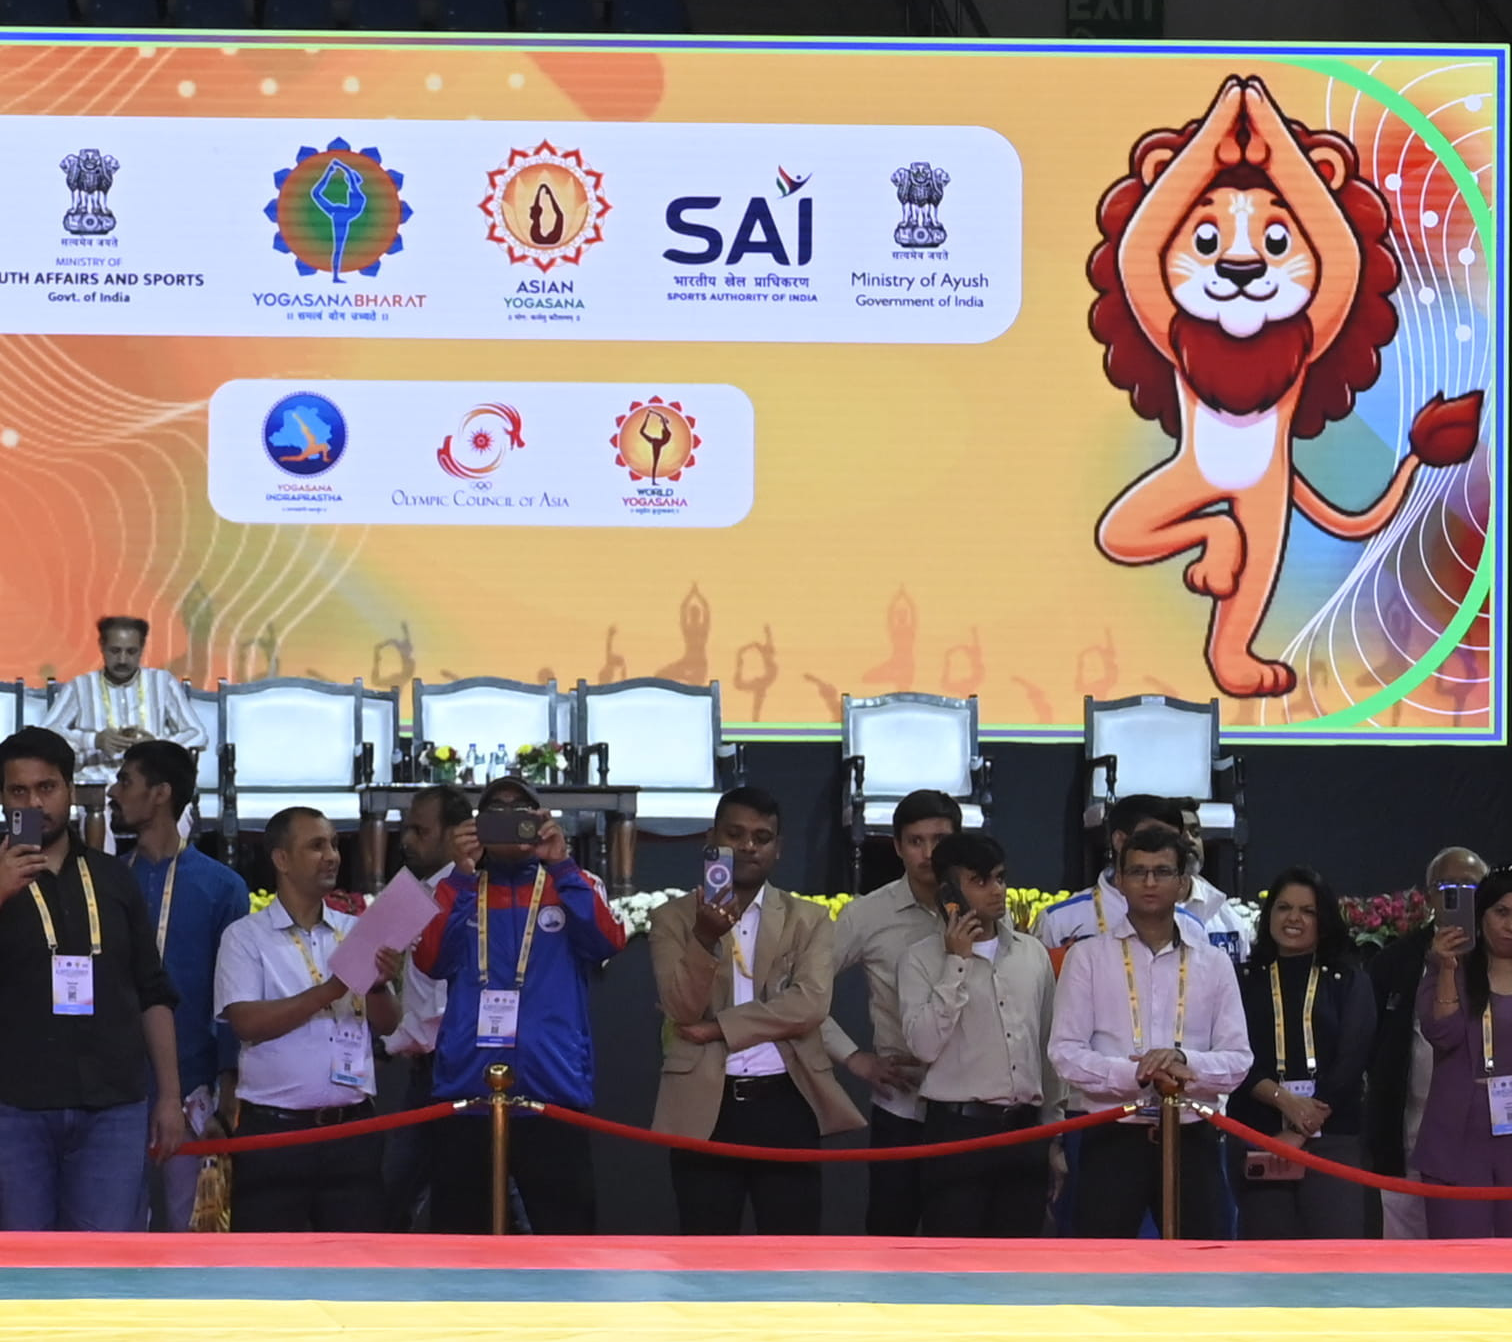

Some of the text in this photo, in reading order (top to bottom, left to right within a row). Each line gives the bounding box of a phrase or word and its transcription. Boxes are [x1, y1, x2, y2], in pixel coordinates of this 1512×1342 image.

[662, 196, 813, 266] SAI
[56, 257, 122, 267] MINISTRY OF
[34, 272, 99, 286] AFFAIRS
[104, 273, 139, 286] AND
[143, 273, 205, 287] SPORTS
[673, 272, 810, 288] भारतीय खेल प्राधिकरण
[851, 272, 989, 291] Ministry of Ayush
[516, 280, 574, 294] ASIAN
[47, 292, 131, 303] Govt. of India
[503, 297, 585, 309] YOGASANA
[667, 292, 818, 302] SPORTS AUTHORITY OF INDIA
[855, 294, 984, 308] Government of India
[622, 497, 688, 507] YOGASANA
